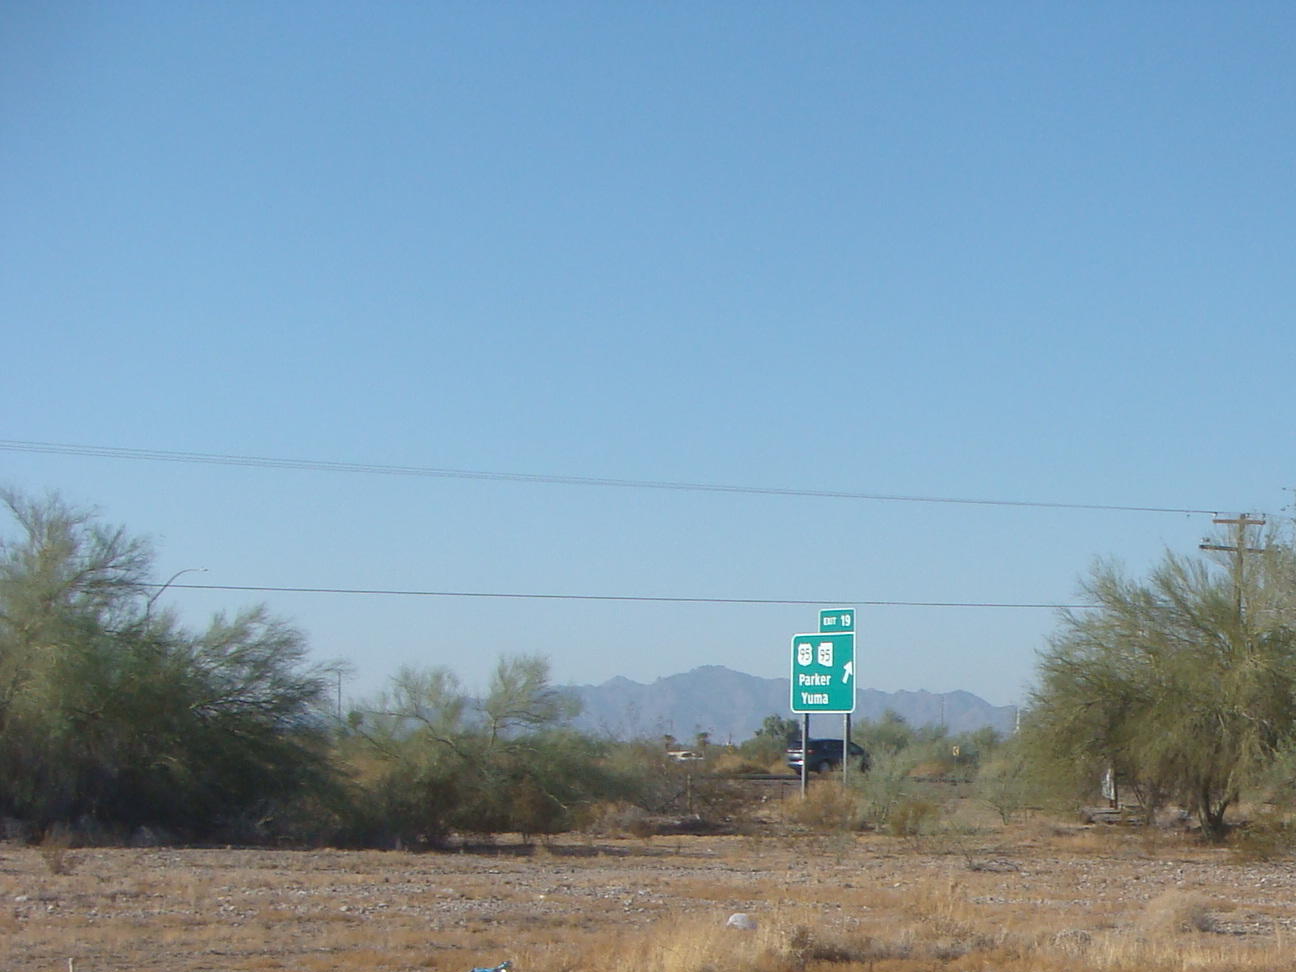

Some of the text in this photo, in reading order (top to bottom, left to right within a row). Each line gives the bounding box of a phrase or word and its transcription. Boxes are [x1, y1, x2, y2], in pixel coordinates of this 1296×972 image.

[823, 615, 851, 626] EXIT 19
[800, 648, 831, 662] 95 95
[799, 673, 831, 686] Parker
[801, 692, 829, 704] Yuma
